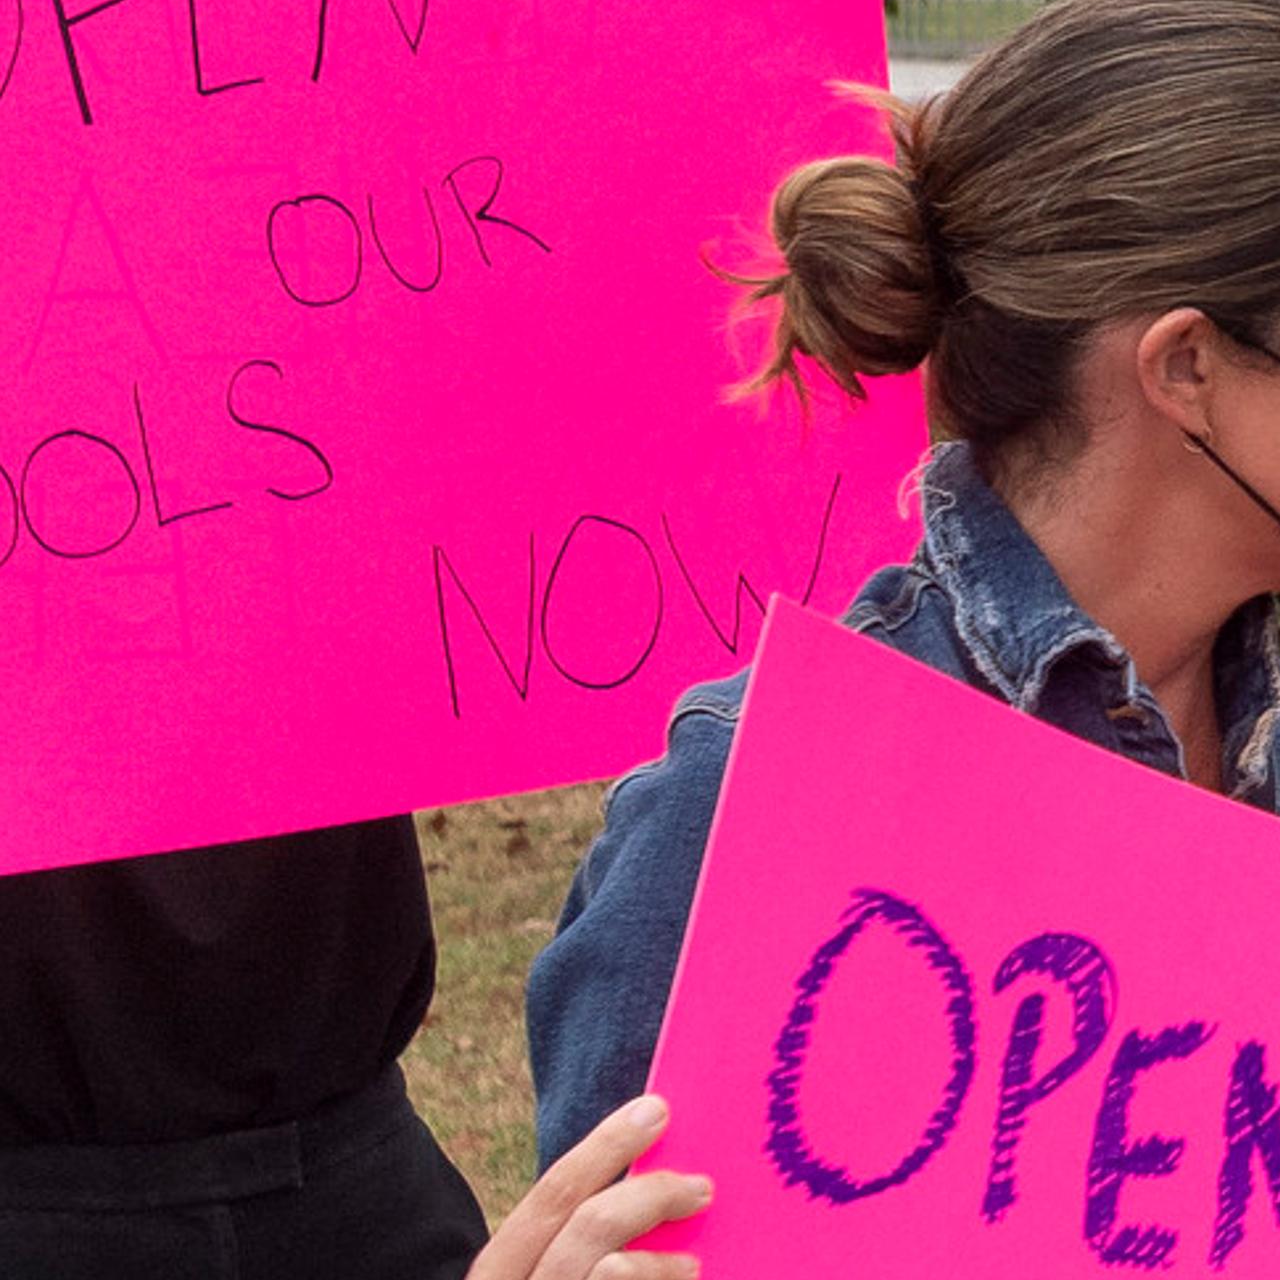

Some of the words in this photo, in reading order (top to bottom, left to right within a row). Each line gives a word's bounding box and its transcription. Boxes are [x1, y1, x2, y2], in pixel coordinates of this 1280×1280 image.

[266, 156, 553, 308] OUR
[0, 359, 334, 567] OLS
[433, 474, 842, 718] NOW
